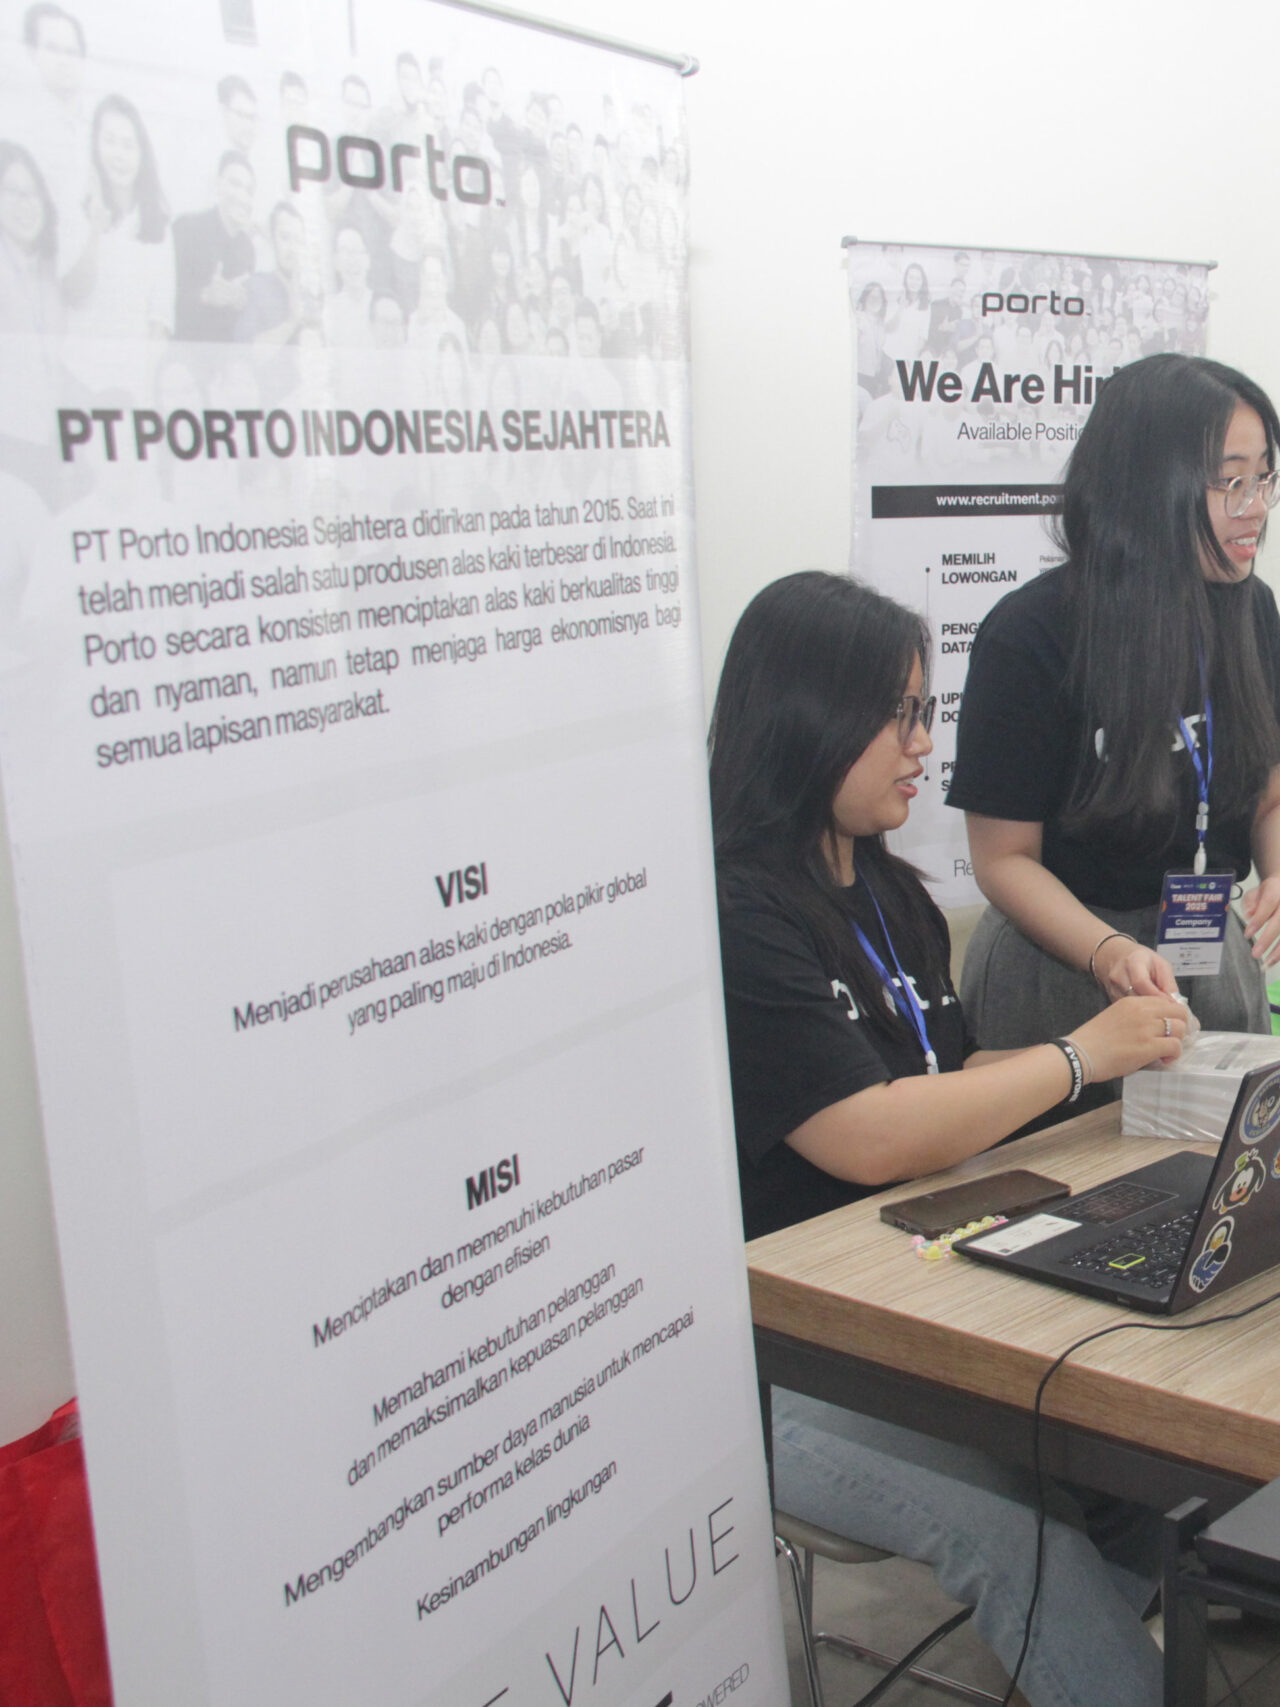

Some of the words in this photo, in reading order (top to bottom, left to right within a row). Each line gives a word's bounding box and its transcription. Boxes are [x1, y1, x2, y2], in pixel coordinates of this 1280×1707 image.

[896, 359, 962, 403] We
[971, 362, 1044, 404] Are
[57, 408, 123, 463] PT
[133, 408, 296, 461] PORTO
[302, 409, 498, 457] INDONESIA
[502, 409, 670, 453] SEJAHTERA
[957, 422, 1032, 441] Available
[1035, 422, 1085, 441] Positi
[72, 529, 109, 564] PT
[118, 527, 189, 560] Porto
[196, 518, 309, 554] Indonesia
[313, 514, 408, 549] Sejahtera
[412, 508, 485, 538] didirikan
[490, 503, 531, 537] pada
[535, 501, 579, 528] tahun
[583, 497, 624, 524] 2015.
[627, 495, 658, 521] Saat
[661, 492, 675, 518] ini
[936, 492, 1061, 508] www.recruitment.po
[78, 580, 144, 616] telah
[148, 570, 245, 609] menjadi
[250, 564, 309, 599] salah
[312, 562, 350, 592] satu
[353, 555, 449, 592] produsen
[452, 550, 485, 577] alas
[488, 546, 521, 572] kaki
[523, 543, 589, 569] terbesar
[593, 539, 606, 561] di
[609, 535, 677, 559] Indonesia.
[942, 552, 995, 566] MEMILIH
[942, 570, 1017, 584] LOWONGAN
[84, 631, 156, 667] Porto
[166, 624, 251, 657] secara
[258, 609, 351, 644] konsisten
[358, 592, 479, 629] menciptakan
[485, 586, 518, 614] alas
[523, 580, 555, 608] kaki
[560, 571, 642, 603] berkualitas
[645, 565, 679, 594] tinggi
[941, 622, 979, 636] PENG
[90, 685, 140, 719] dan
[155, 671, 258, 712] nyaman,
[271, 658, 337, 690] namun
[346, 647, 399, 676] tetap
[411, 634, 487, 666] menjaga
[496, 627, 543, 653] harga
[551, 610, 649, 643] ekonomisnya
[655, 605, 681, 629] bagi
[96, 730, 183, 769] semua
[185, 715, 271, 754] lapisan
[275, 689, 390, 735] masyarakat.
[435, 862, 488, 908] VISI
[1172, 893, 1202, 903] TALENT
[1203, 893, 1224, 903] FAIR
[1175, 918, 1213, 928] Company
[233, 983, 316, 1032] Menjadi
[319, 950, 416, 1009] perusahaan
[419, 938, 455, 966] alas
[457, 922, 488, 953] kaki
[490, 907, 543, 942] dengan
[545, 894, 575, 925] pola
[576, 882, 604, 914] pikir
[607, 867, 647, 904] global
[348, 998, 387, 1036] yang
[390, 979, 444, 1019] paling
[447, 962, 485, 994] maju
[487, 953, 500, 979] di
[502, 931, 573, 973] Indonesia.
[466, 1154, 520, 1211] MISI
[313, 1269, 417, 1348] Menciptakan
[420, 1252, 454, 1282] dan
[457, 1208, 535, 1265] memenuhi
[536, 1167, 606, 1220] kebutuhan
[608, 1147, 644, 1184] pasar
[441, 1263, 503, 1309] dengan
[505, 1235, 550, 1274] efisien
[348, 1451, 376, 1487] dan
[377, 1367, 508, 1462] memaksimalkan
[509, 1322, 576, 1378] kepuasan
[578, 1277, 643, 1337] pelanggan
[373, 1351, 465, 1426] Memahami
[468, 1307, 545, 1368] kebutuhan
[547, 1263, 615, 1323] pelanggan
[284, 1485, 434, 1607] Mengembangkan
[437, 1443, 499, 1497] sumber
[503, 1418, 538, 1455] daya
[540, 1377, 595, 1429] manusia
[596, 1350, 631, 1388] untuk
[632, 1306, 694, 1362] mencapai
[438, 1470, 513, 1538] performa
[513, 1442, 552, 1484] kelas
[554, 1414, 590, 1453] dunia
[417, 1516, 545, 1621] Kesinambungan
[546, 1461, 616, 1526] lingkungan
[545, 1496, 740, 1707] VALUE
